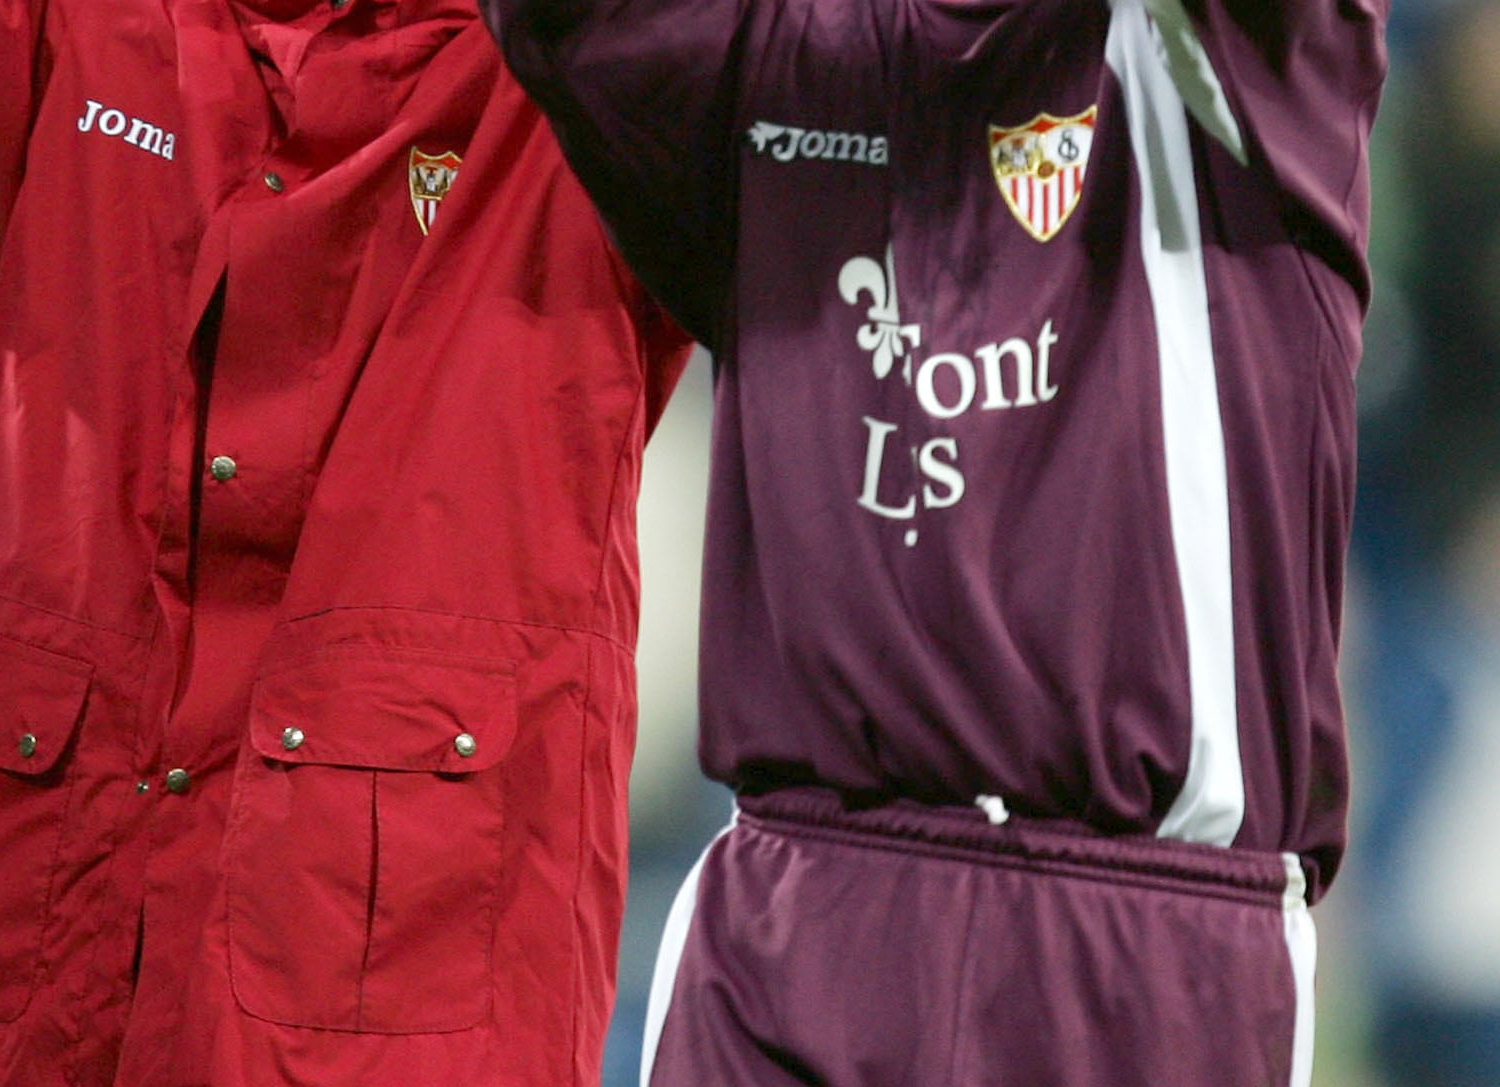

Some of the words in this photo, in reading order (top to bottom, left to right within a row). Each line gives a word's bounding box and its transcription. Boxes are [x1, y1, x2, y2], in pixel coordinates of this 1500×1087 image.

[77, 100, 175, 160] Joma
[771, 127, 889, 165] Joma
[857, 415, 965, 547] Ls
